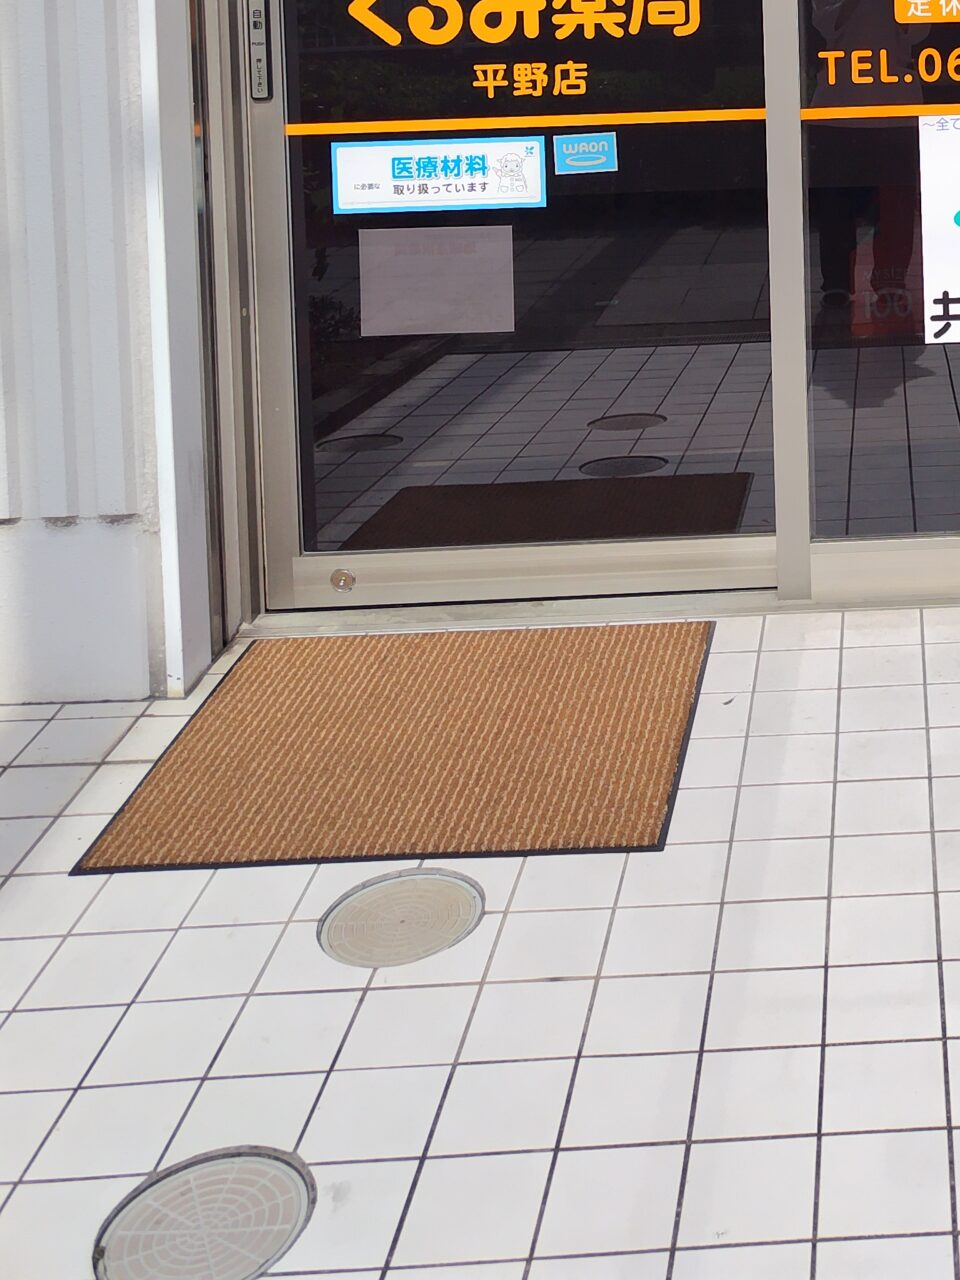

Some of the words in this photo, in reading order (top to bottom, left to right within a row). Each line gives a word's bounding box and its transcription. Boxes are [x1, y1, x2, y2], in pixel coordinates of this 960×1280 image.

[472, 60, 589, 99] 平野店
[391, 154, 489, 180] 医療材料
[392, 182, 489, 196] 取り扱っています
